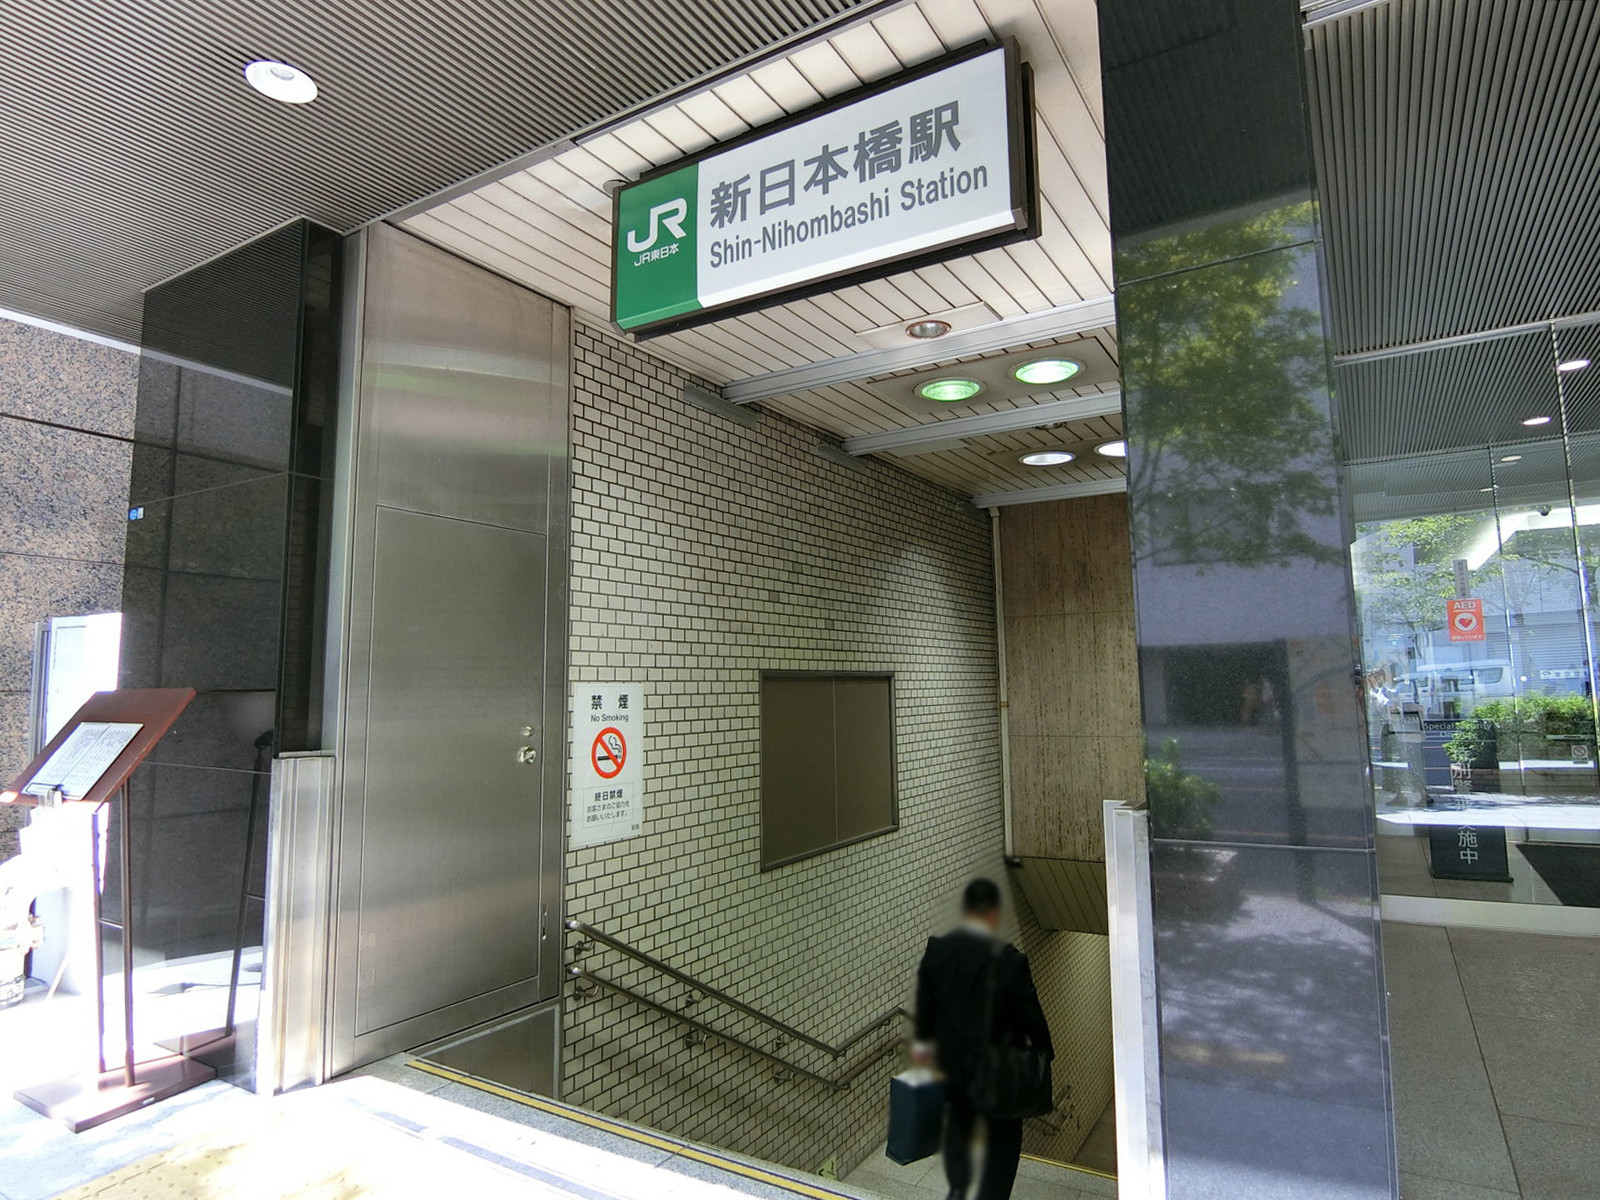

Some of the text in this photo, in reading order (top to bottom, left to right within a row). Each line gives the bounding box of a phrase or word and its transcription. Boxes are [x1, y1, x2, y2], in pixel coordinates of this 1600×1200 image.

[709, 100, 962, 230] 新日本橋駅
[626, 197, 688, 253] JR
[710, 164, 988, 269] Shin-Nihombashi Station
[634, 243, 680, 267] JR東日本
[1453, 601, 1476, 609] AED
[590, 713, 629, 723] No Smoking
[594, 789, 623, 802] 終日禁煙
[1452, 745, 1479, 865] 特別警戒施中
